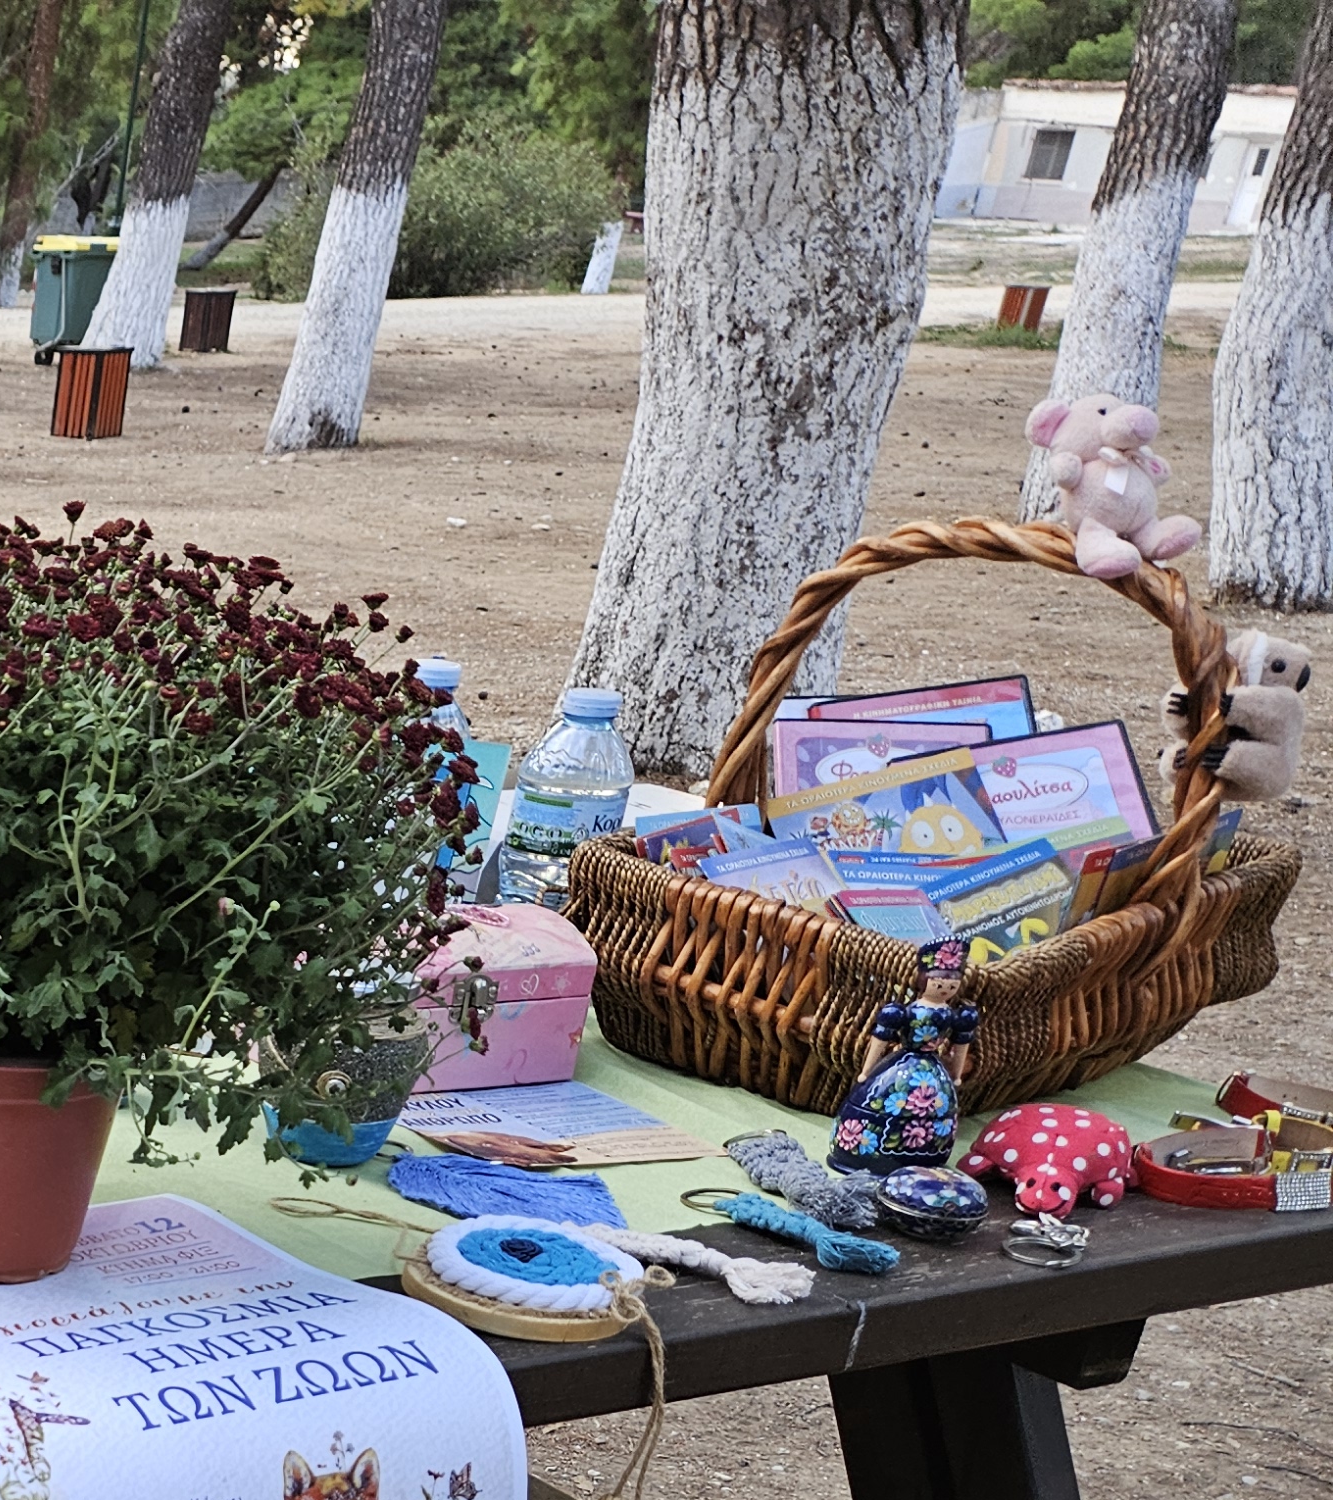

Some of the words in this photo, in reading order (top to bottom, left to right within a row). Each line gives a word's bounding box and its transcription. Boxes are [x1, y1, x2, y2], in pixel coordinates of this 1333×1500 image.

[951, 695, 983, 707] ΤΑΙΝΙΑ
[786, 799, 798, 810] ΤΑ
[800, 785, 857, 805] ΩΡΑΙΟΤΕΡΑ
[859, 767, 921, 791] ΚΙΝΟΥΜΕΝΑ
[922, 757, 959, 772] ΣΧΕΔΙΑ
[842, 870, 856, 878] ΤΑ
[857, 871, 911, 881] ΩΡΑΙΟΤΕΡΑ
[928, 878, 971, 900] ΩΡΑΙΟΤΕΡΑ
[972, 861, 1014, 882] ΚΙΝΟΥΜΕΝΑ
[1015, 850, 1042, 866] ΣΧΕΔΙΑ
[401, 1113, 502, 1127] ΑΝΘΡΩΠΟ
[135, 1217, 186, 1234] 12
[70, 1229, 199, 1263] ΟΚΤΩΒΡΙΟΥ
[96, 1255, 178, 1275] ΚΤΗΜΑ
[178, 1246, 219, 1260] ΦΙΞ
[13, 1289, 359, 1357] ΠΑΓΚΟΣΜΙΑ
[123, 1319, 348, 1373] ΗΜΕΡΑ
[112, 1374, 256, 1431] ΤΩΝ
[252, 1339, 440, 1404] ΖΩΩΝ
